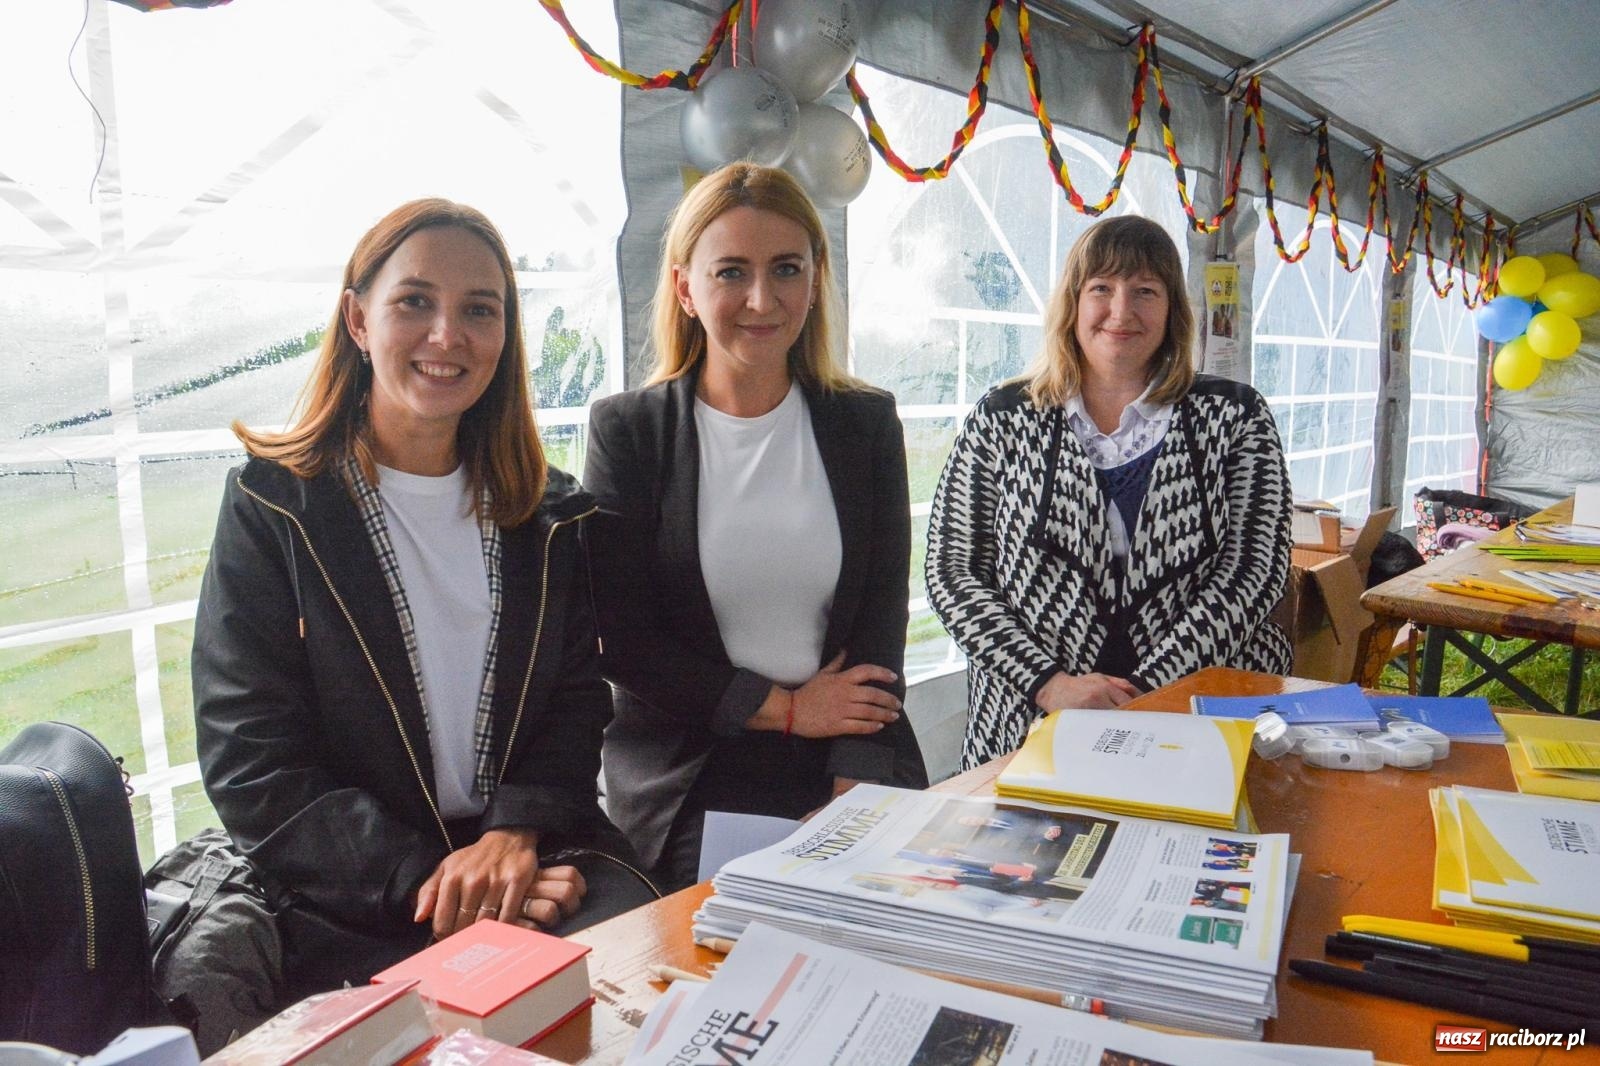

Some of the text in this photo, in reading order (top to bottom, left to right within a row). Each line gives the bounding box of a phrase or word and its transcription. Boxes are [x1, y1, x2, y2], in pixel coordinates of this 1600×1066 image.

[1103, 729, 1131, 755] STIMME
[781, 806, 858, 856] OBERSCHLESISCHE
[796, 808, 889, 861] STIMME
[1555, 819, 1589, 854] STIMME
